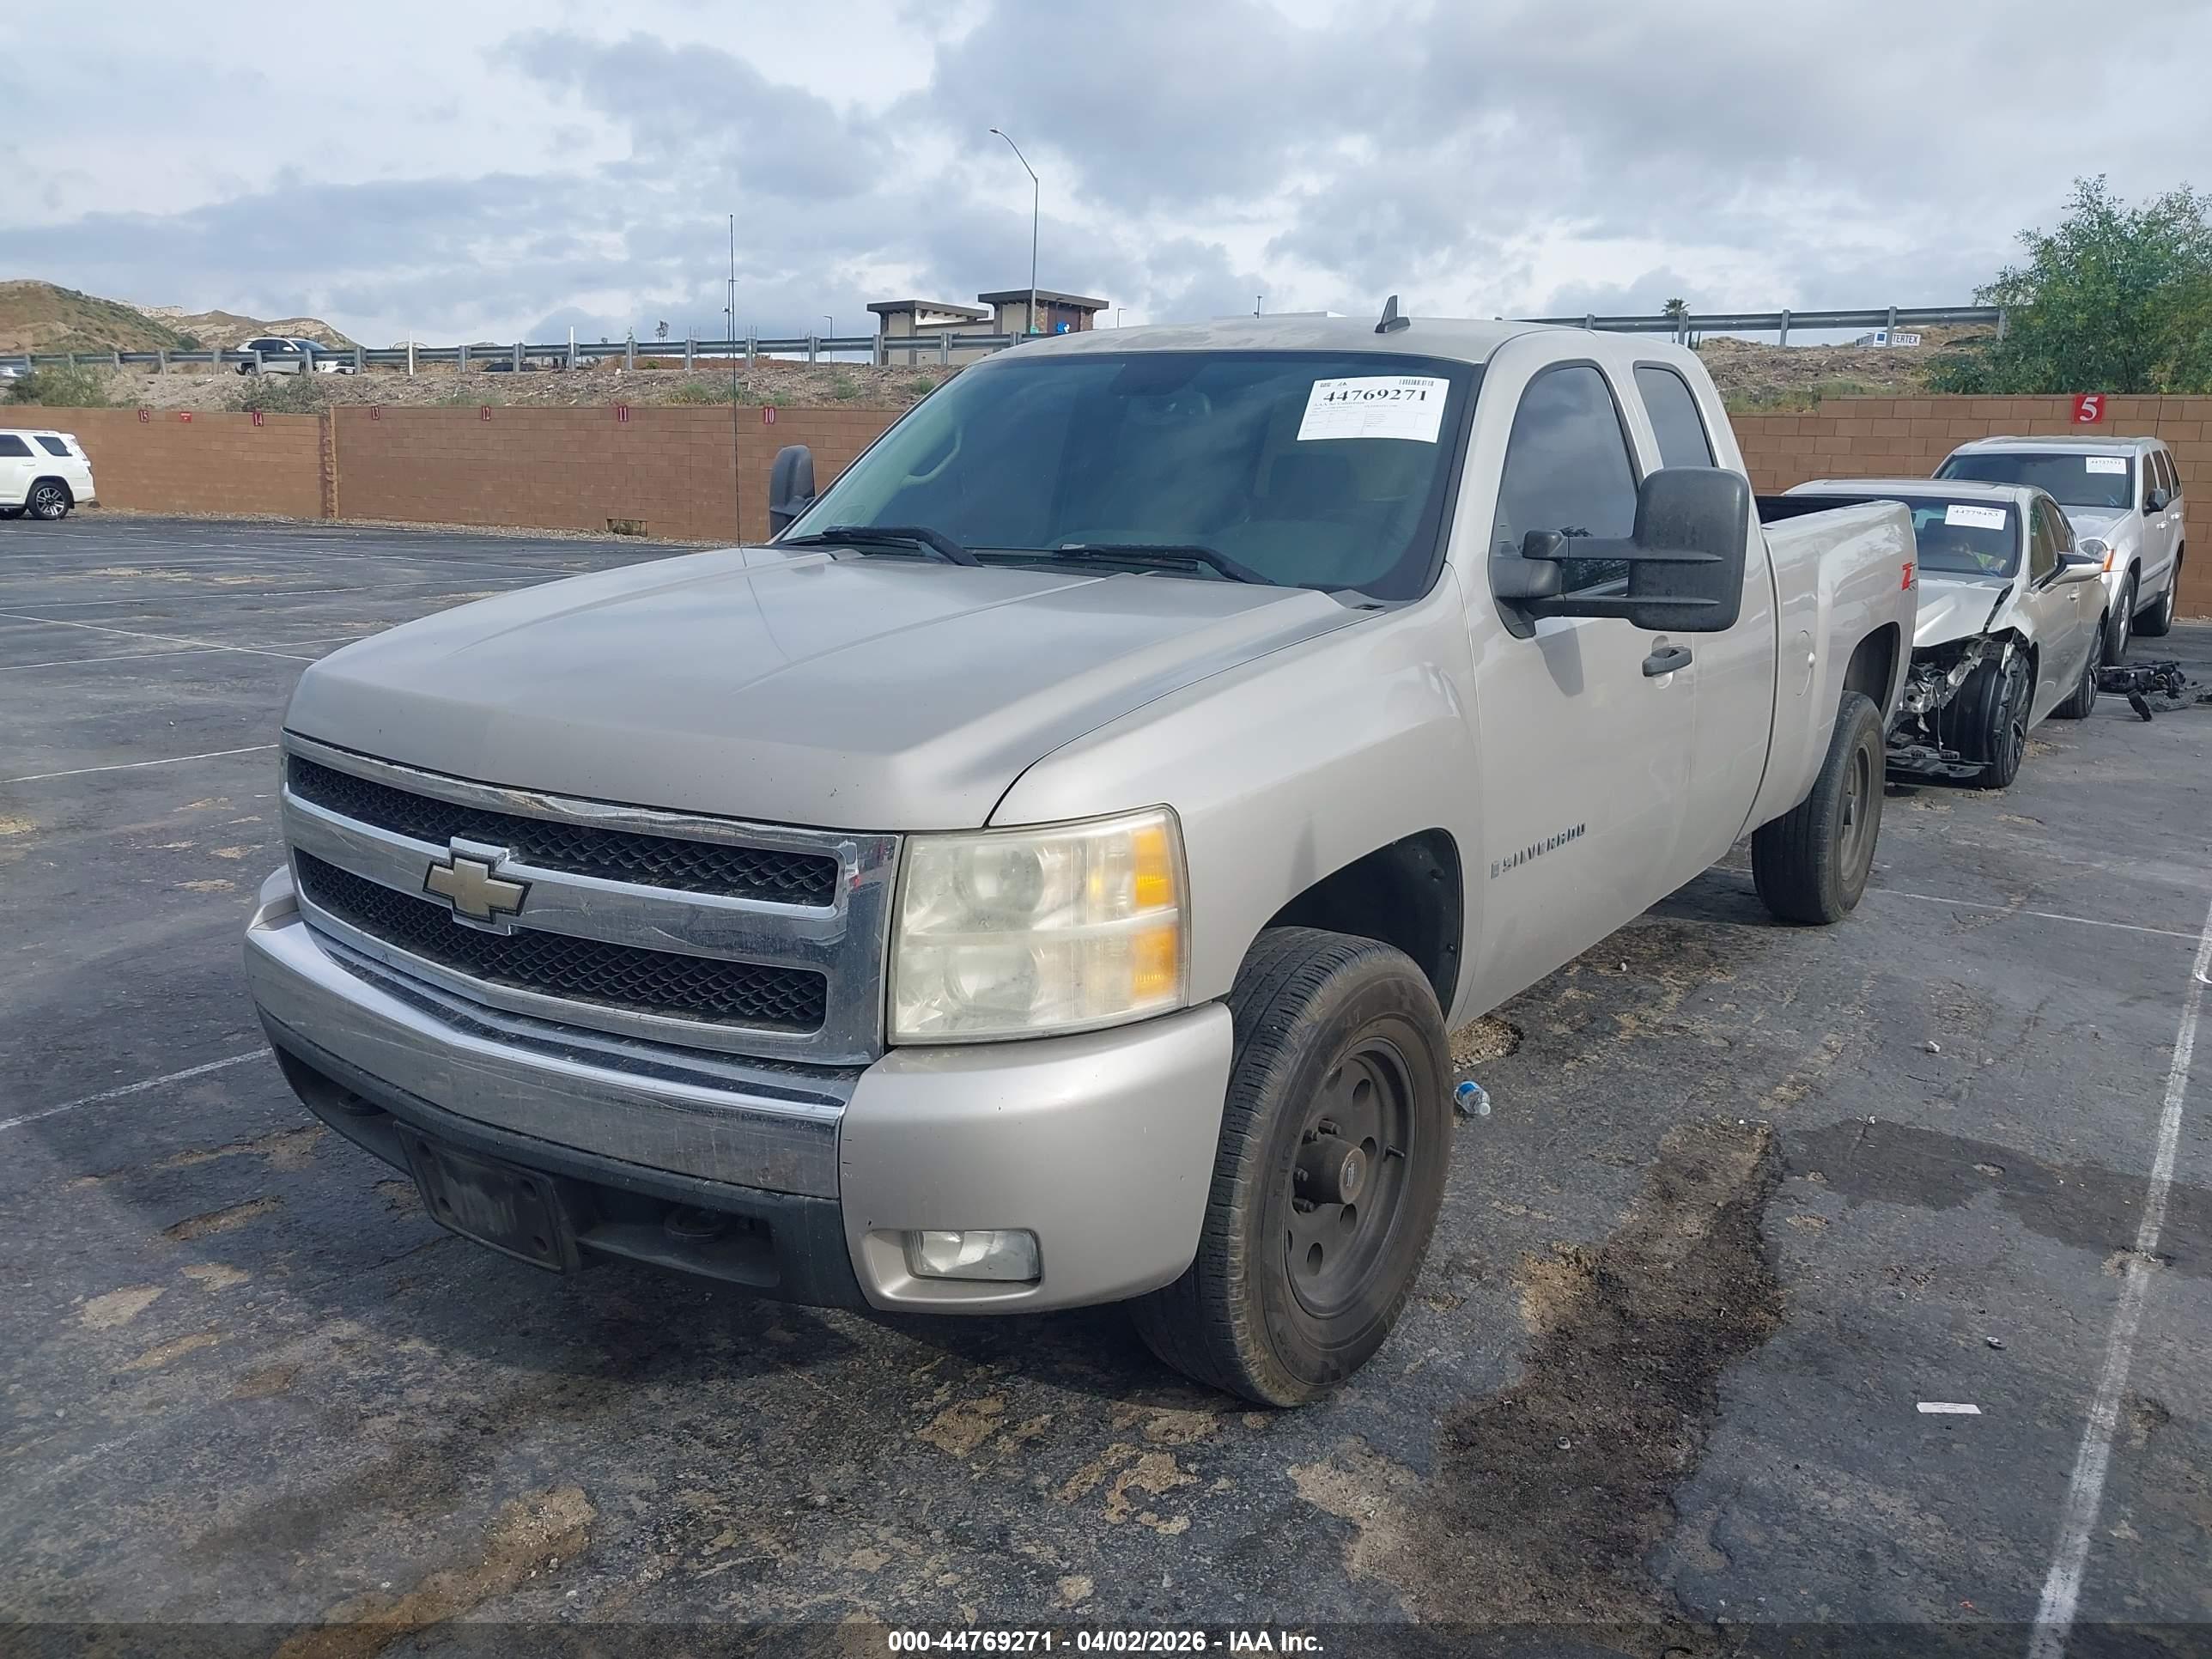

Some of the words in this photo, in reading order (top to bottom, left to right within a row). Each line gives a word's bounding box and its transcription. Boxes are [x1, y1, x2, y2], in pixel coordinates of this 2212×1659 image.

[1323, 389, 1427, 402] 44769271
[372, 407, 380, 420] 13
[482, 406, 490, 420] 12
[618, 407, 628, 422] 11
[764, 408, 775, 423] 10
[2079, 397, 2099, 421] 5
[253, 413, 263, 426] 14
[1503, 823, 1586, 872] SILVERADO
